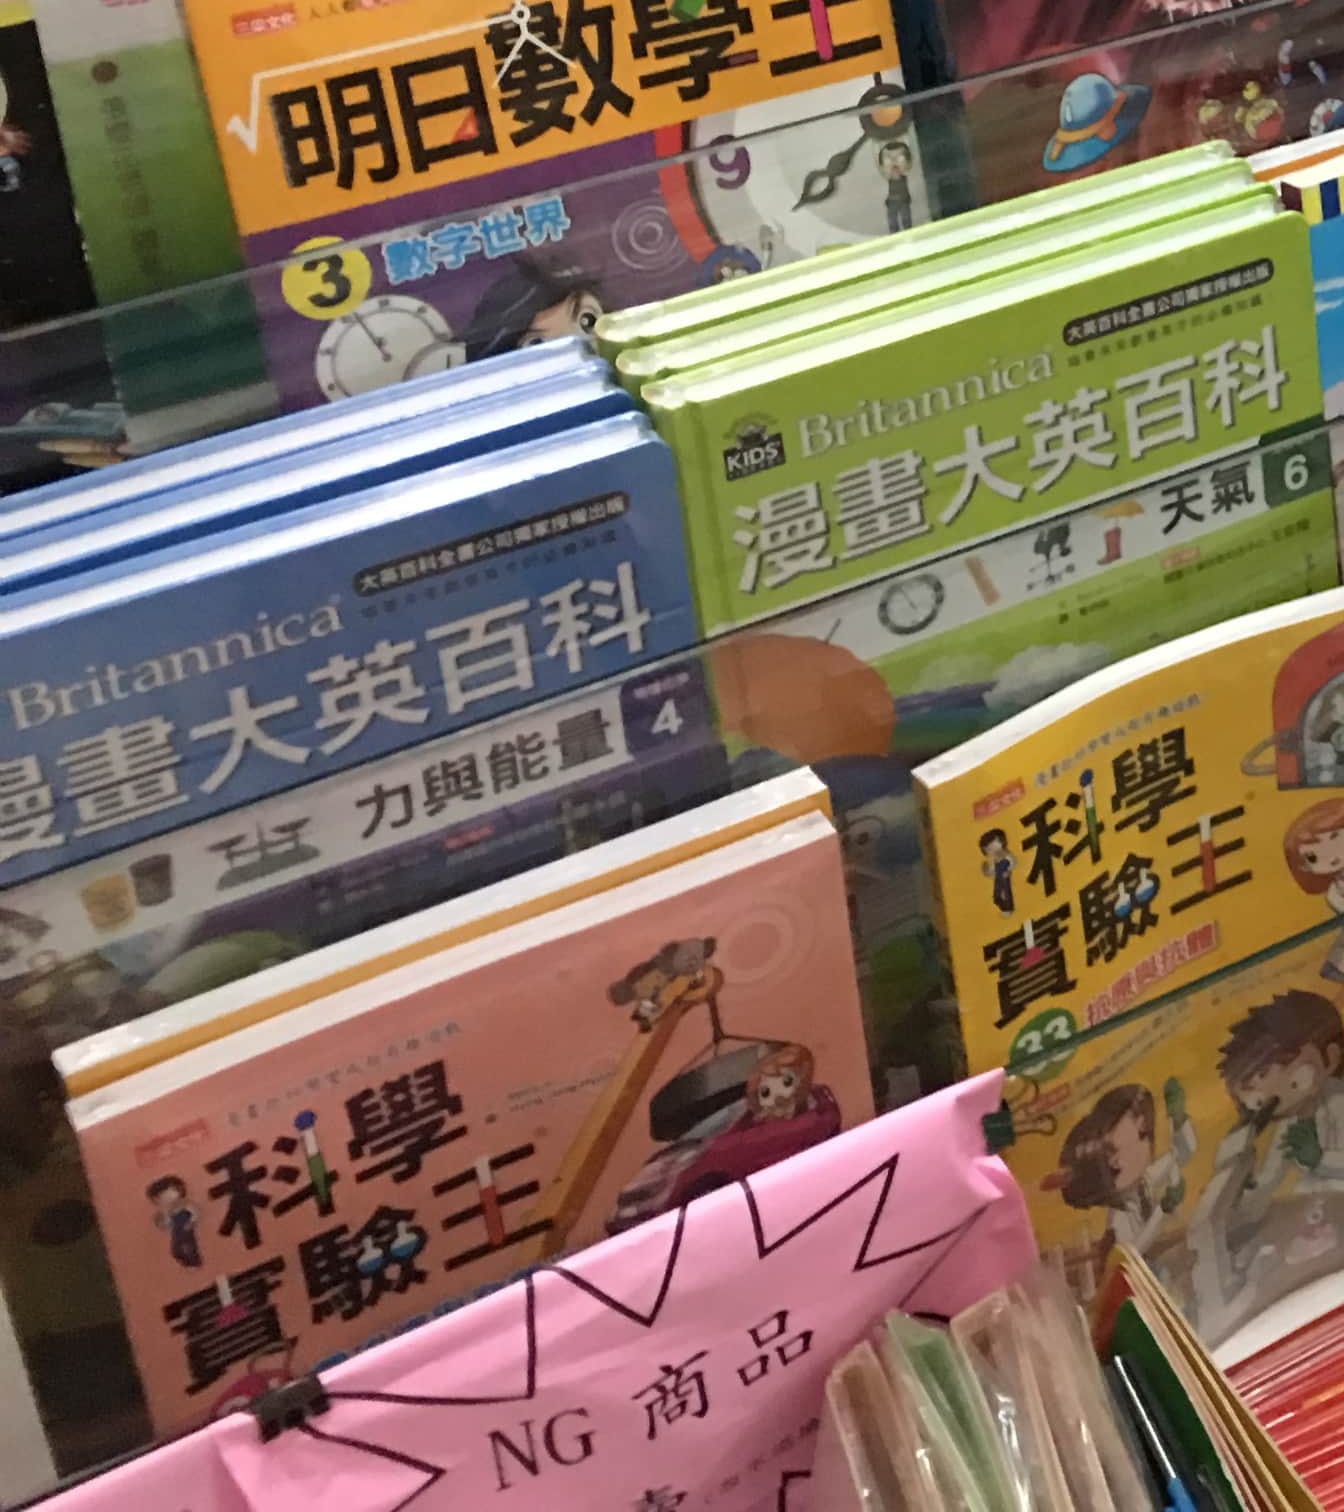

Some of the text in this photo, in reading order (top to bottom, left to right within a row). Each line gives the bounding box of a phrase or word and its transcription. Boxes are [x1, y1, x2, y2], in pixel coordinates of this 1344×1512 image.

[303, 245, 354, 318] 3
[383, 191, 575, 289] 數字世界
[722, 323, 1290, 595] 漫畫大英百科
[724, 440, 783, 472] KIDS
[798, 345, 1056, 460] Britannica
[1160, 468, 1255, 536] 天氣
[1283, 453, 1310, 489] 6
[10, 592, 346, 734] Britannica
[652, 701, 684, 736] 4
[355, 707, 617, 839] 力與能量
[1021, 728, 1195, 898] 科學
[982, 803, 1254, 1030] 實驗王
[203, 1058, 469, 1251] 科學
[162, 1143, 557, 1401] 實驗王
[488, 1306, 815, 1492] NG 商品
